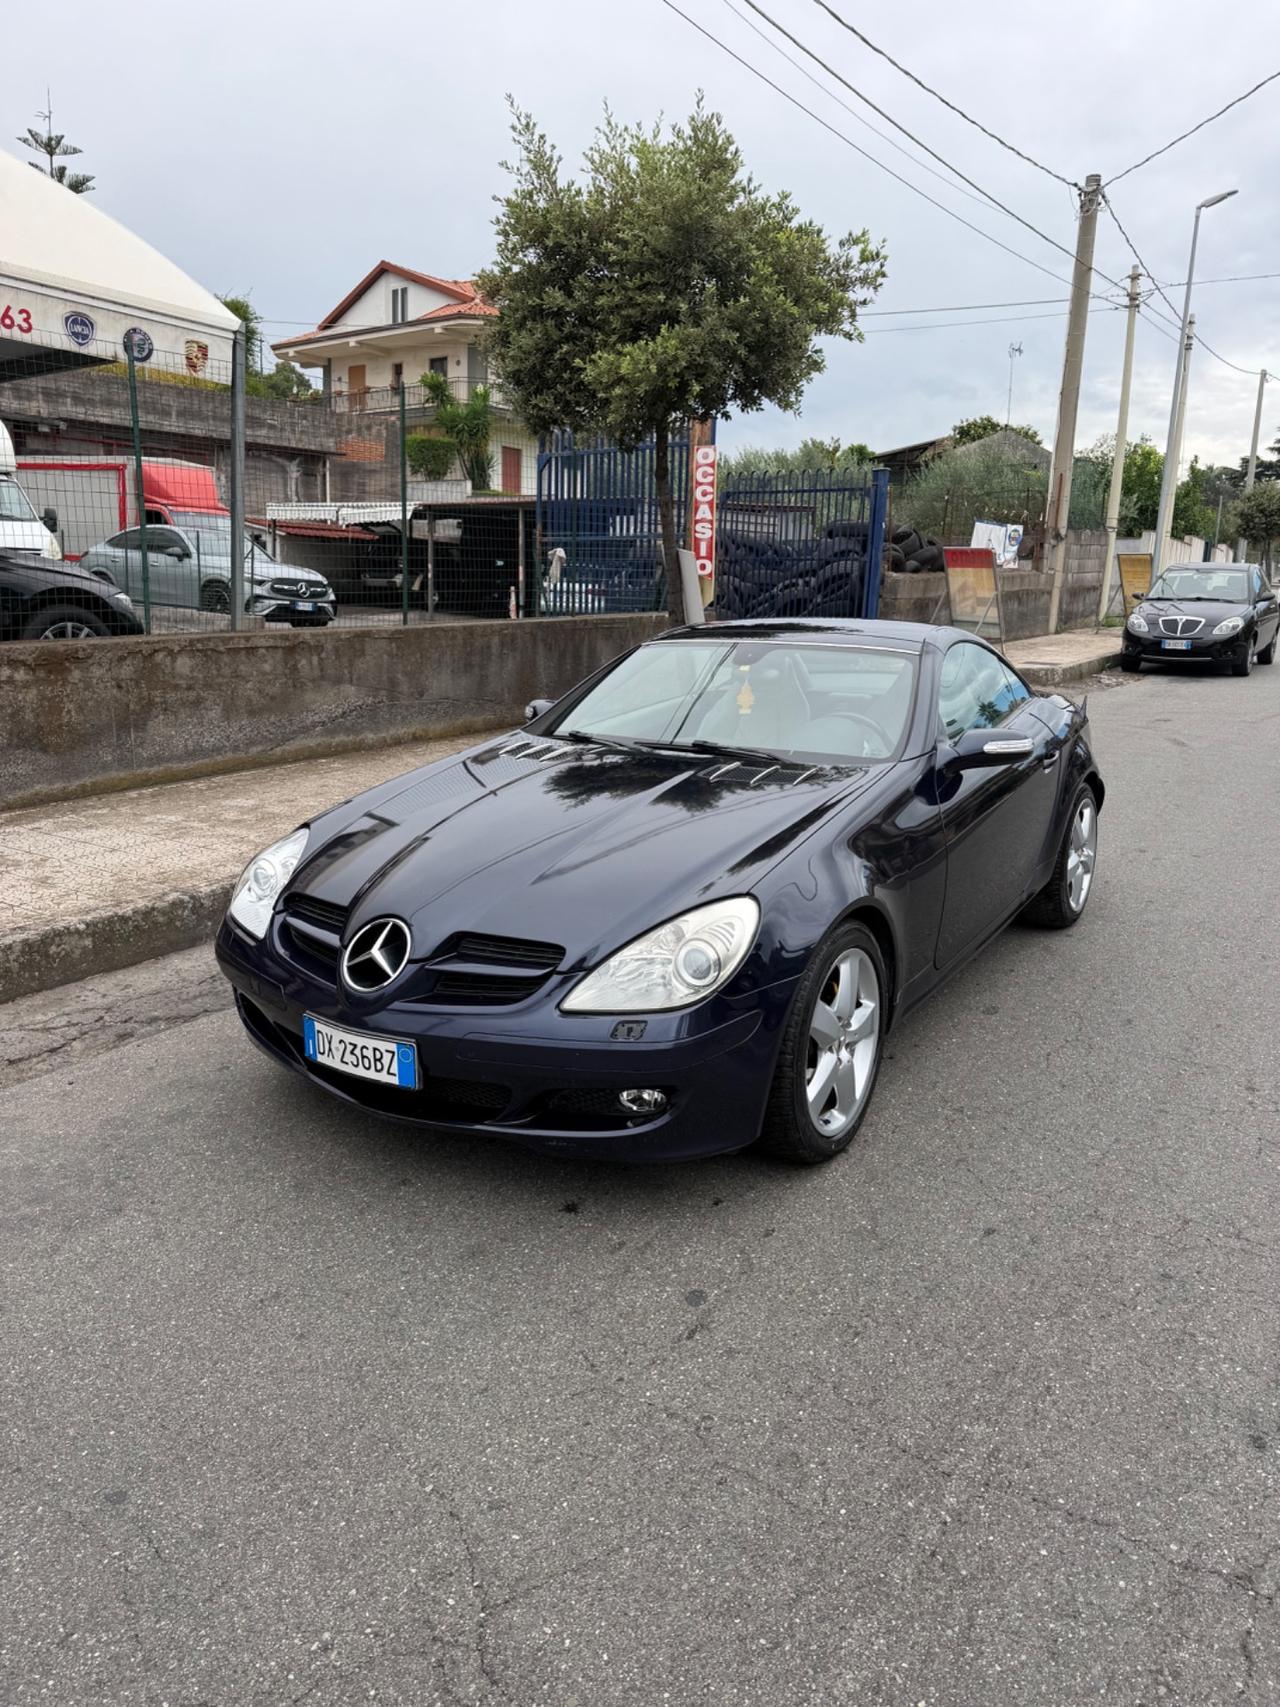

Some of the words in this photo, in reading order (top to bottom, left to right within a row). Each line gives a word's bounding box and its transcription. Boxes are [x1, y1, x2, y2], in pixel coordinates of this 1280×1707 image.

[0, 305, 33, 334] 63
[695, 447, 715, 576] OCCASIO
[316, 1029, 335, 1060] DX
[338, 1038, 397, 1077] 236BZ
